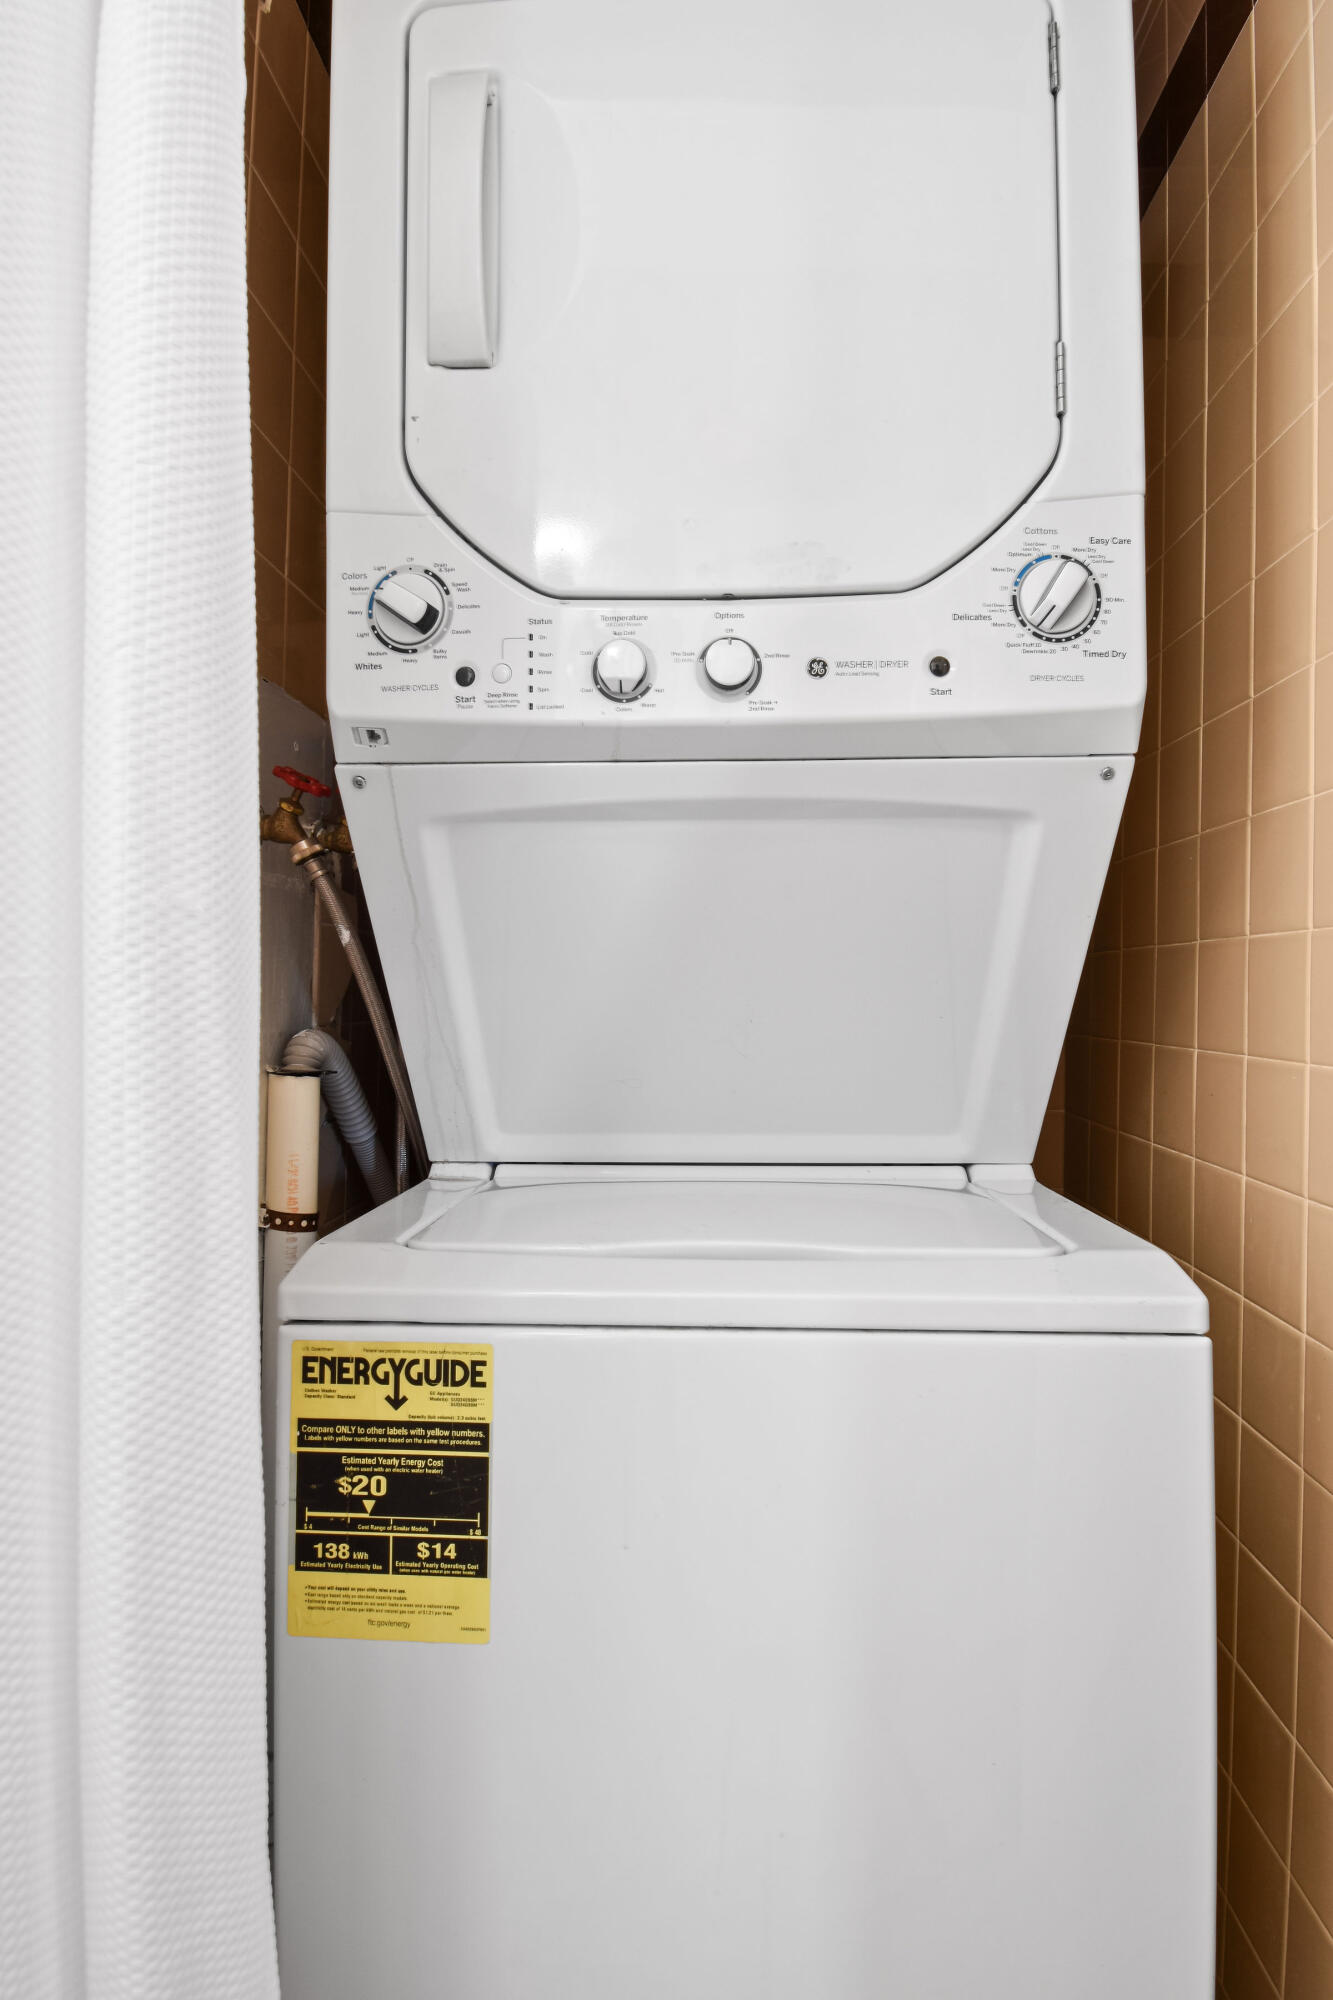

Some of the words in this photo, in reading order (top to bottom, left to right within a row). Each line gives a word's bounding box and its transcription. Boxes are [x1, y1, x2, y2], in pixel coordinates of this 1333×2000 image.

[1024, 527, 1058, 535] Cottons
[1090, 536, 1110, 546] Easy
[1112, 536, 1132, 545] Care
[342, 572, 368, 580] Colors
[714, 612, 745, 620] Options
[1082, 650, 1110, 658] Timed
[1111, 650, 1128, 660] Dry
[354, 662, 383, 670] Whites
[836, 660, 874, 669] WASHER
[880, 660, 910, 669] DRYER
[930, 688, 952, 696] Start
[455, 696, 476, 704] Start
[302, 1356, 488, 1389] ENERGYGUIDE
[301, 1424, 334, 1433] Compare
[336, 1425, 356, 1434] ONLY
[366, 1426, 386, 1434] other
[387, 1427, 408, 1436] labels
[410, 1428, 426, 1436] with
[427, 1428, 450, 1437] yellow
[451, 1429, 486, 1438] numbers.
[341, 1456, 377, 1465] Estimated
[378, 1456, 400, 1467] Yearly
[401, 1458, 426, 1468] Energy
[427, 1458, 444, 1467] Cost
[337, 1474, 388, 1497] $20
[313, 1542, 350, 1560] 138
[353, 1552, 369, 1560] kWh
[416, 1542, 457, 1560] $14
[327, 1562, 344, 1570] Yearly
[345, 1562, 371, 1570] Electricity
[422, 1562, 439, 1570] Yearly
[440, 1562, 466, 1570] Operating
[368, 1618, 411, 1629] ftc.gov/energy
